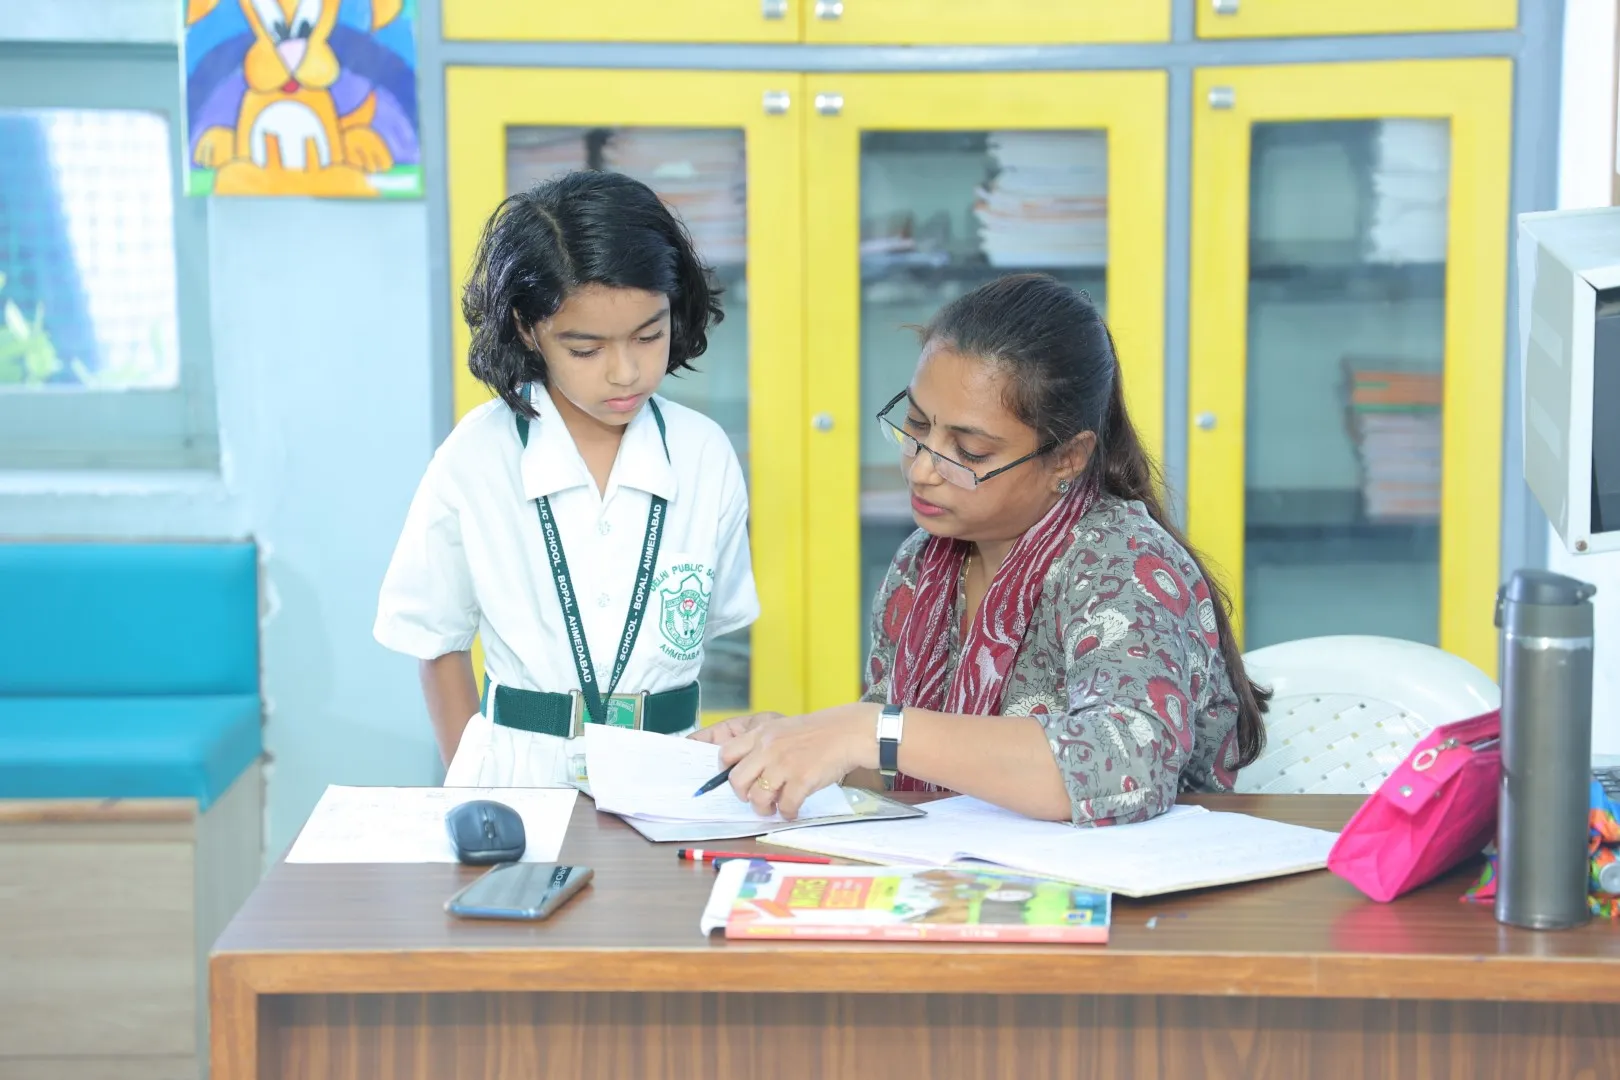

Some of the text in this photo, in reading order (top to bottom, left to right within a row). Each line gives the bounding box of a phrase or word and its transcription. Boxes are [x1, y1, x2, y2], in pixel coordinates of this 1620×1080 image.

[538, 496, 549, 520] BLIC
[544, 522, 561, 567] SCHOOL
[568, 615, 592, 683] AHMEDABAD
[620, 618, 638, 661] SCHOOL
[643, 504, 662, 571] AHMEDABAD
[650, 570, 670, 592] DELHI
[672, 563, 704, 575] PUBLIC
[659, 643, 700, 661] AHMEDABA
